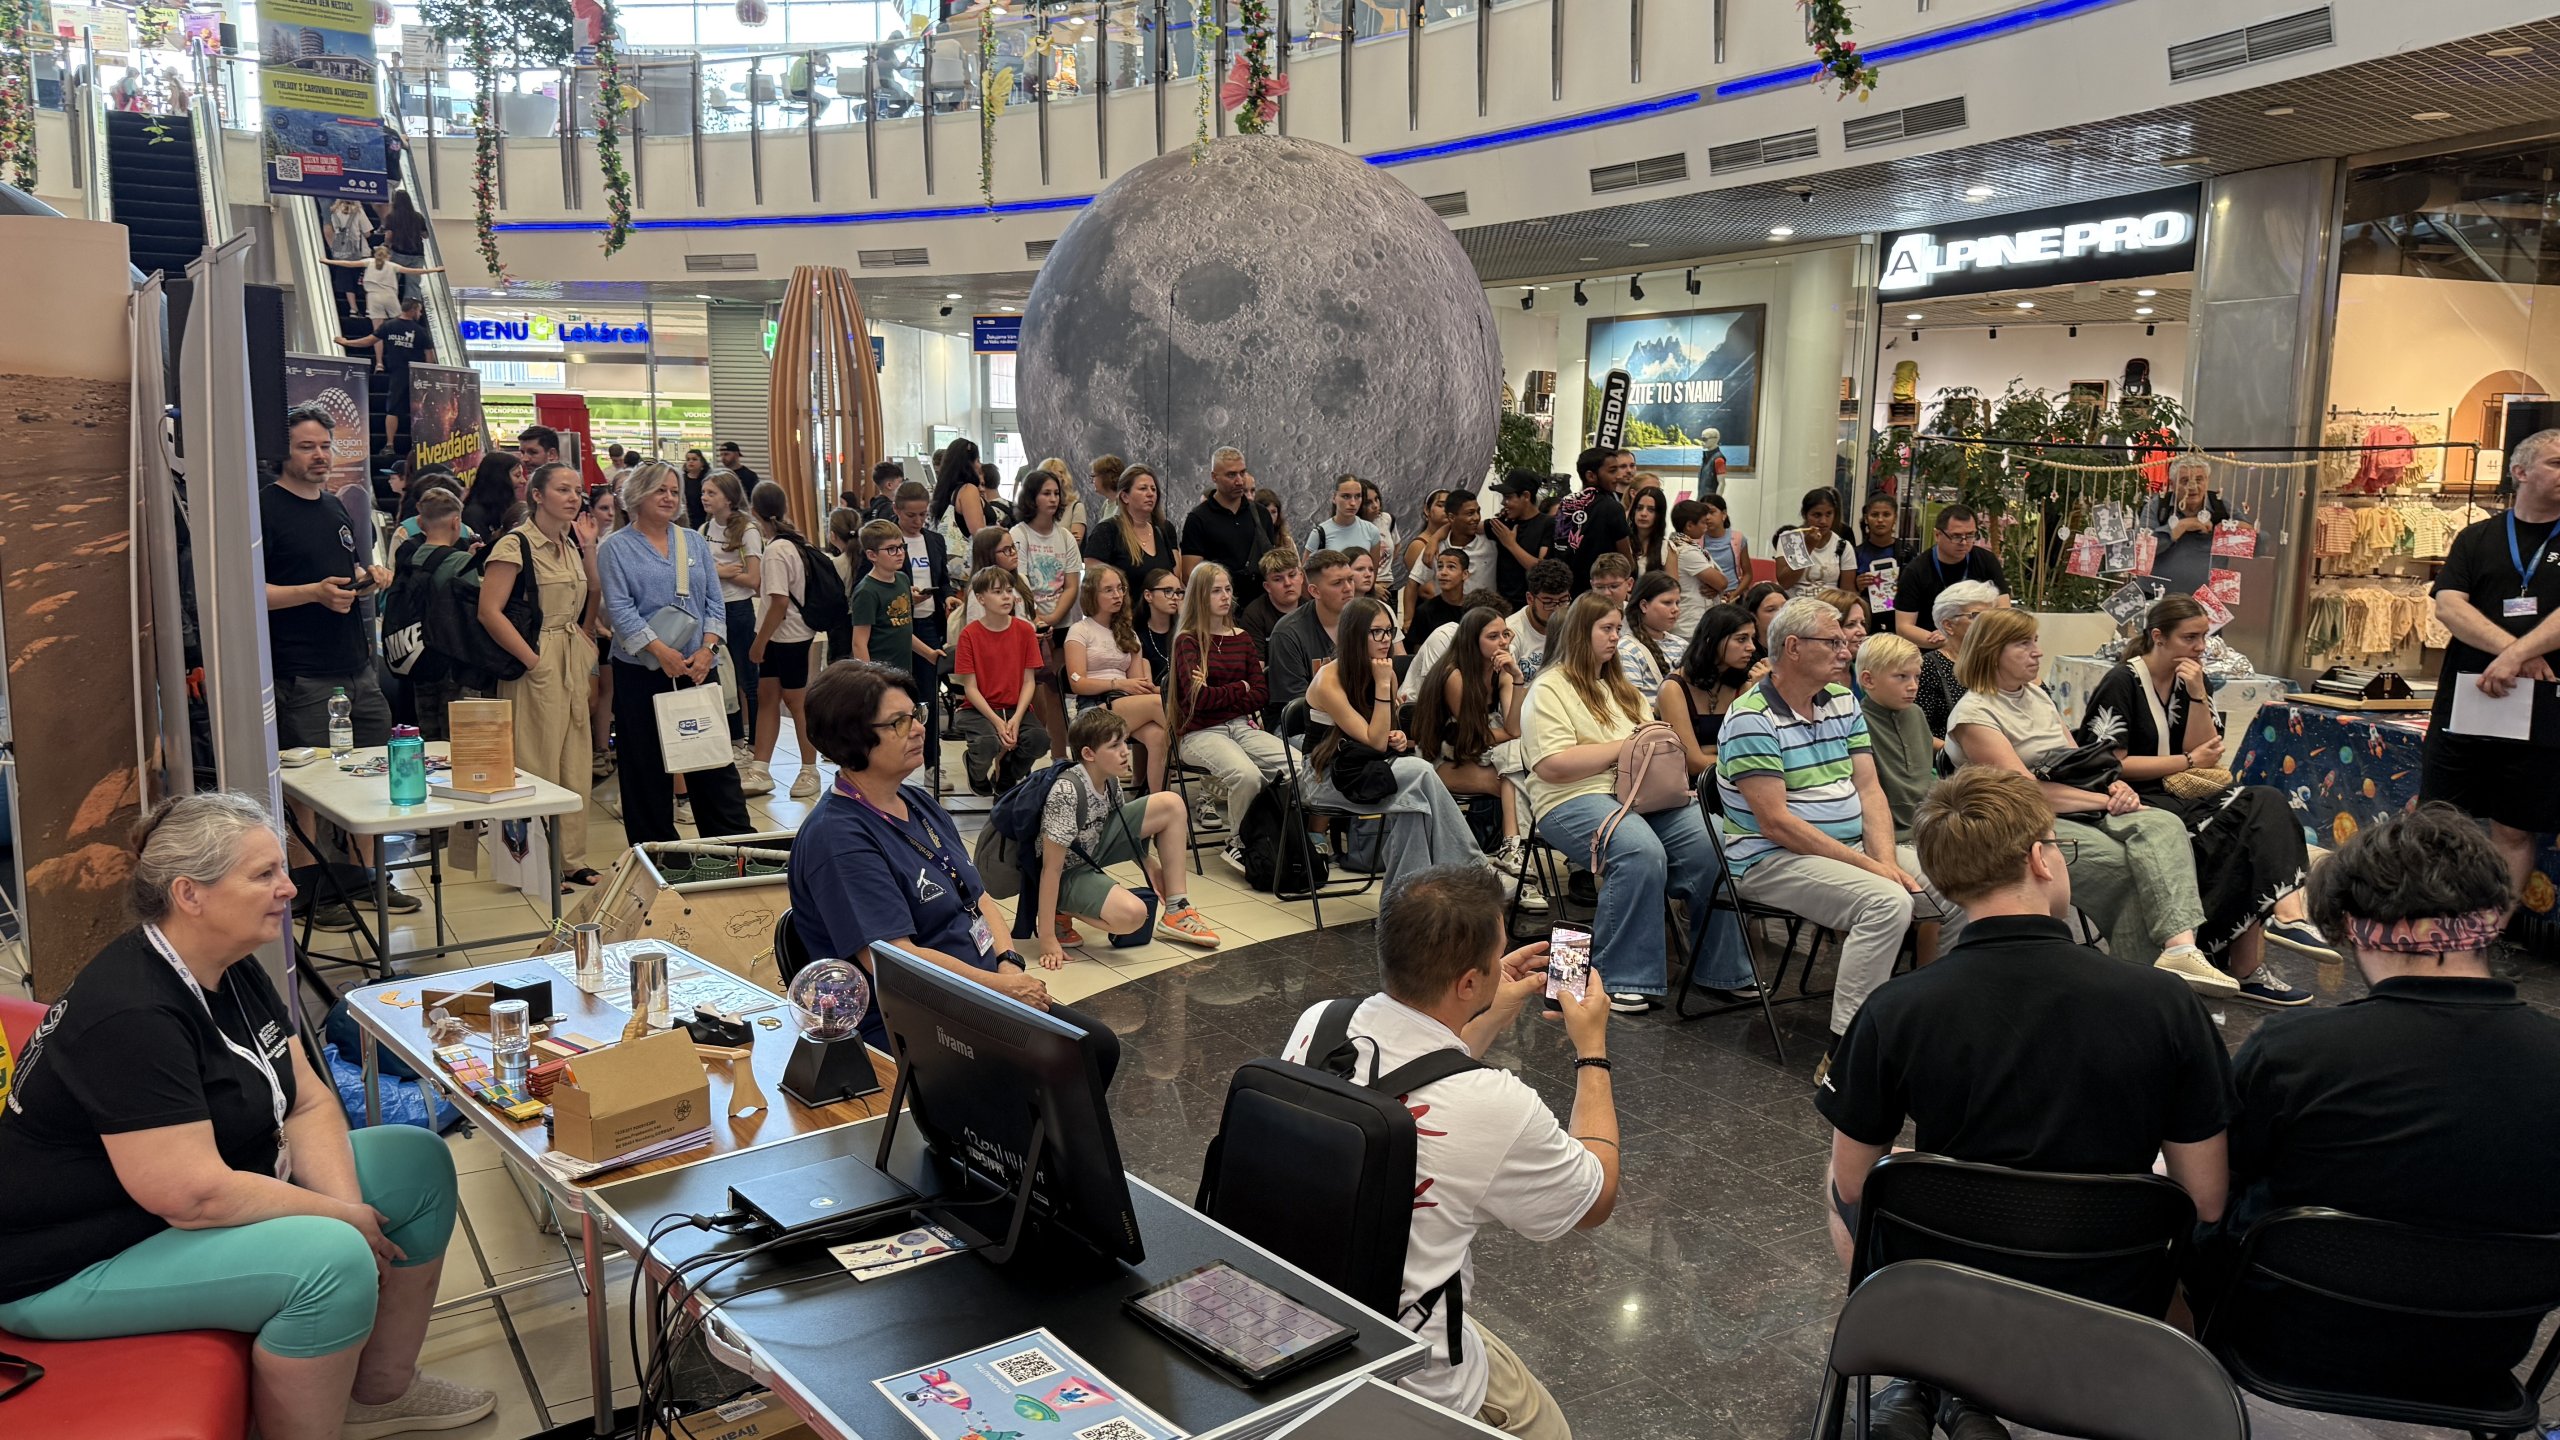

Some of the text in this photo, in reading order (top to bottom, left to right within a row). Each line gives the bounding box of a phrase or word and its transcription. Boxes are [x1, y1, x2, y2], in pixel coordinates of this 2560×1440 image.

[463, 320, 650, 343] BENU Lekáreň
[1656, 383, 1673, 405] TO
[1674, 382, 1684, 404] S
[1685, 379, 1724, 404] NAMI!
[416, 423, 480, 471] Hvezdáreň
[384, 621, 424, 663] NIKE
[936, 1026, 975, 1060] iiyama
